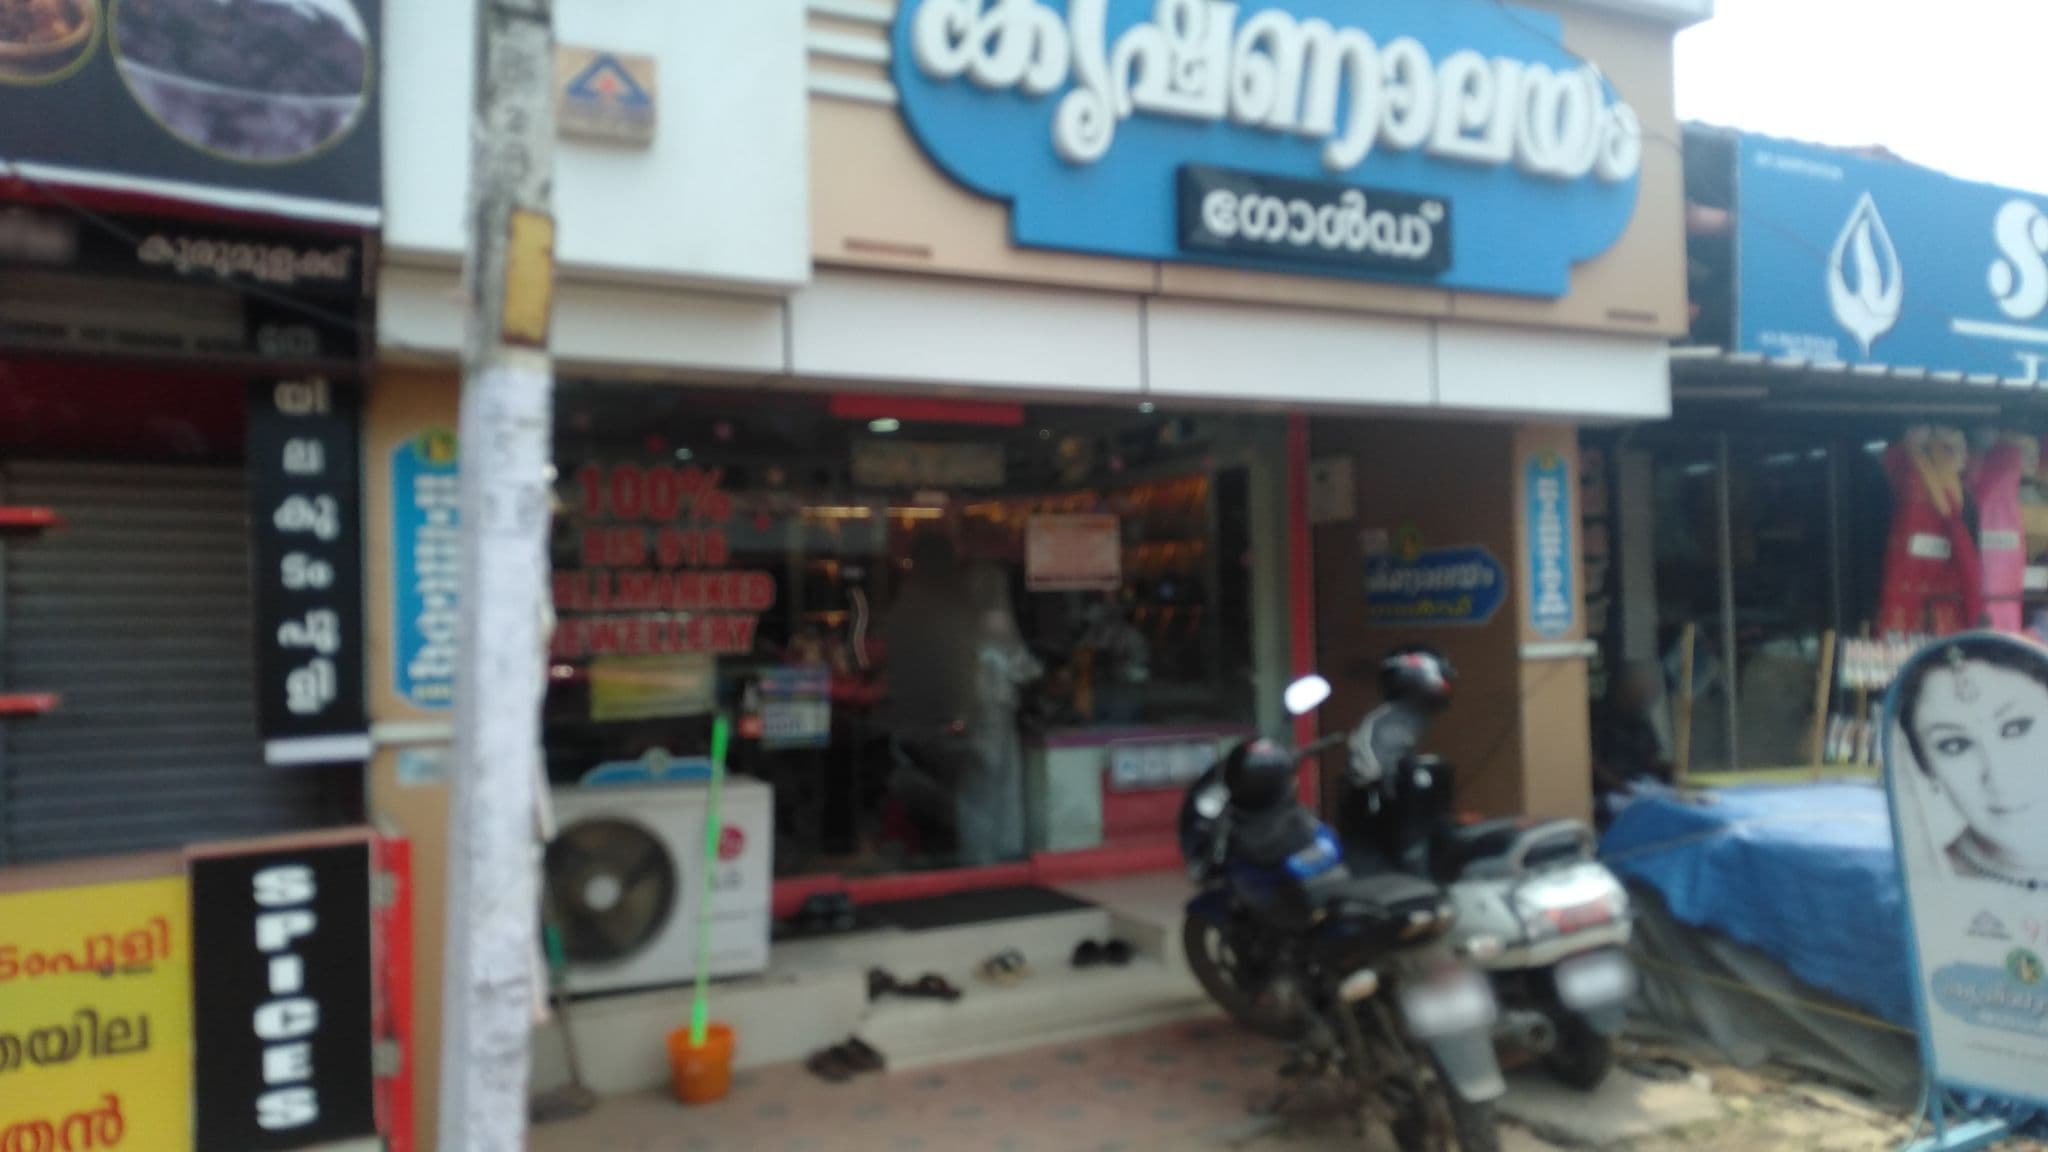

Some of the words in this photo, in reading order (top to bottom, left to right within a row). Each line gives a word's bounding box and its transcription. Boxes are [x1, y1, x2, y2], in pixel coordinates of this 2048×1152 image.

[1202, 189, 1444, 258] ഗോൾഡ്
[577, 465, 734, 523] 100%
[251, 864, 319, 1131] SPICES
